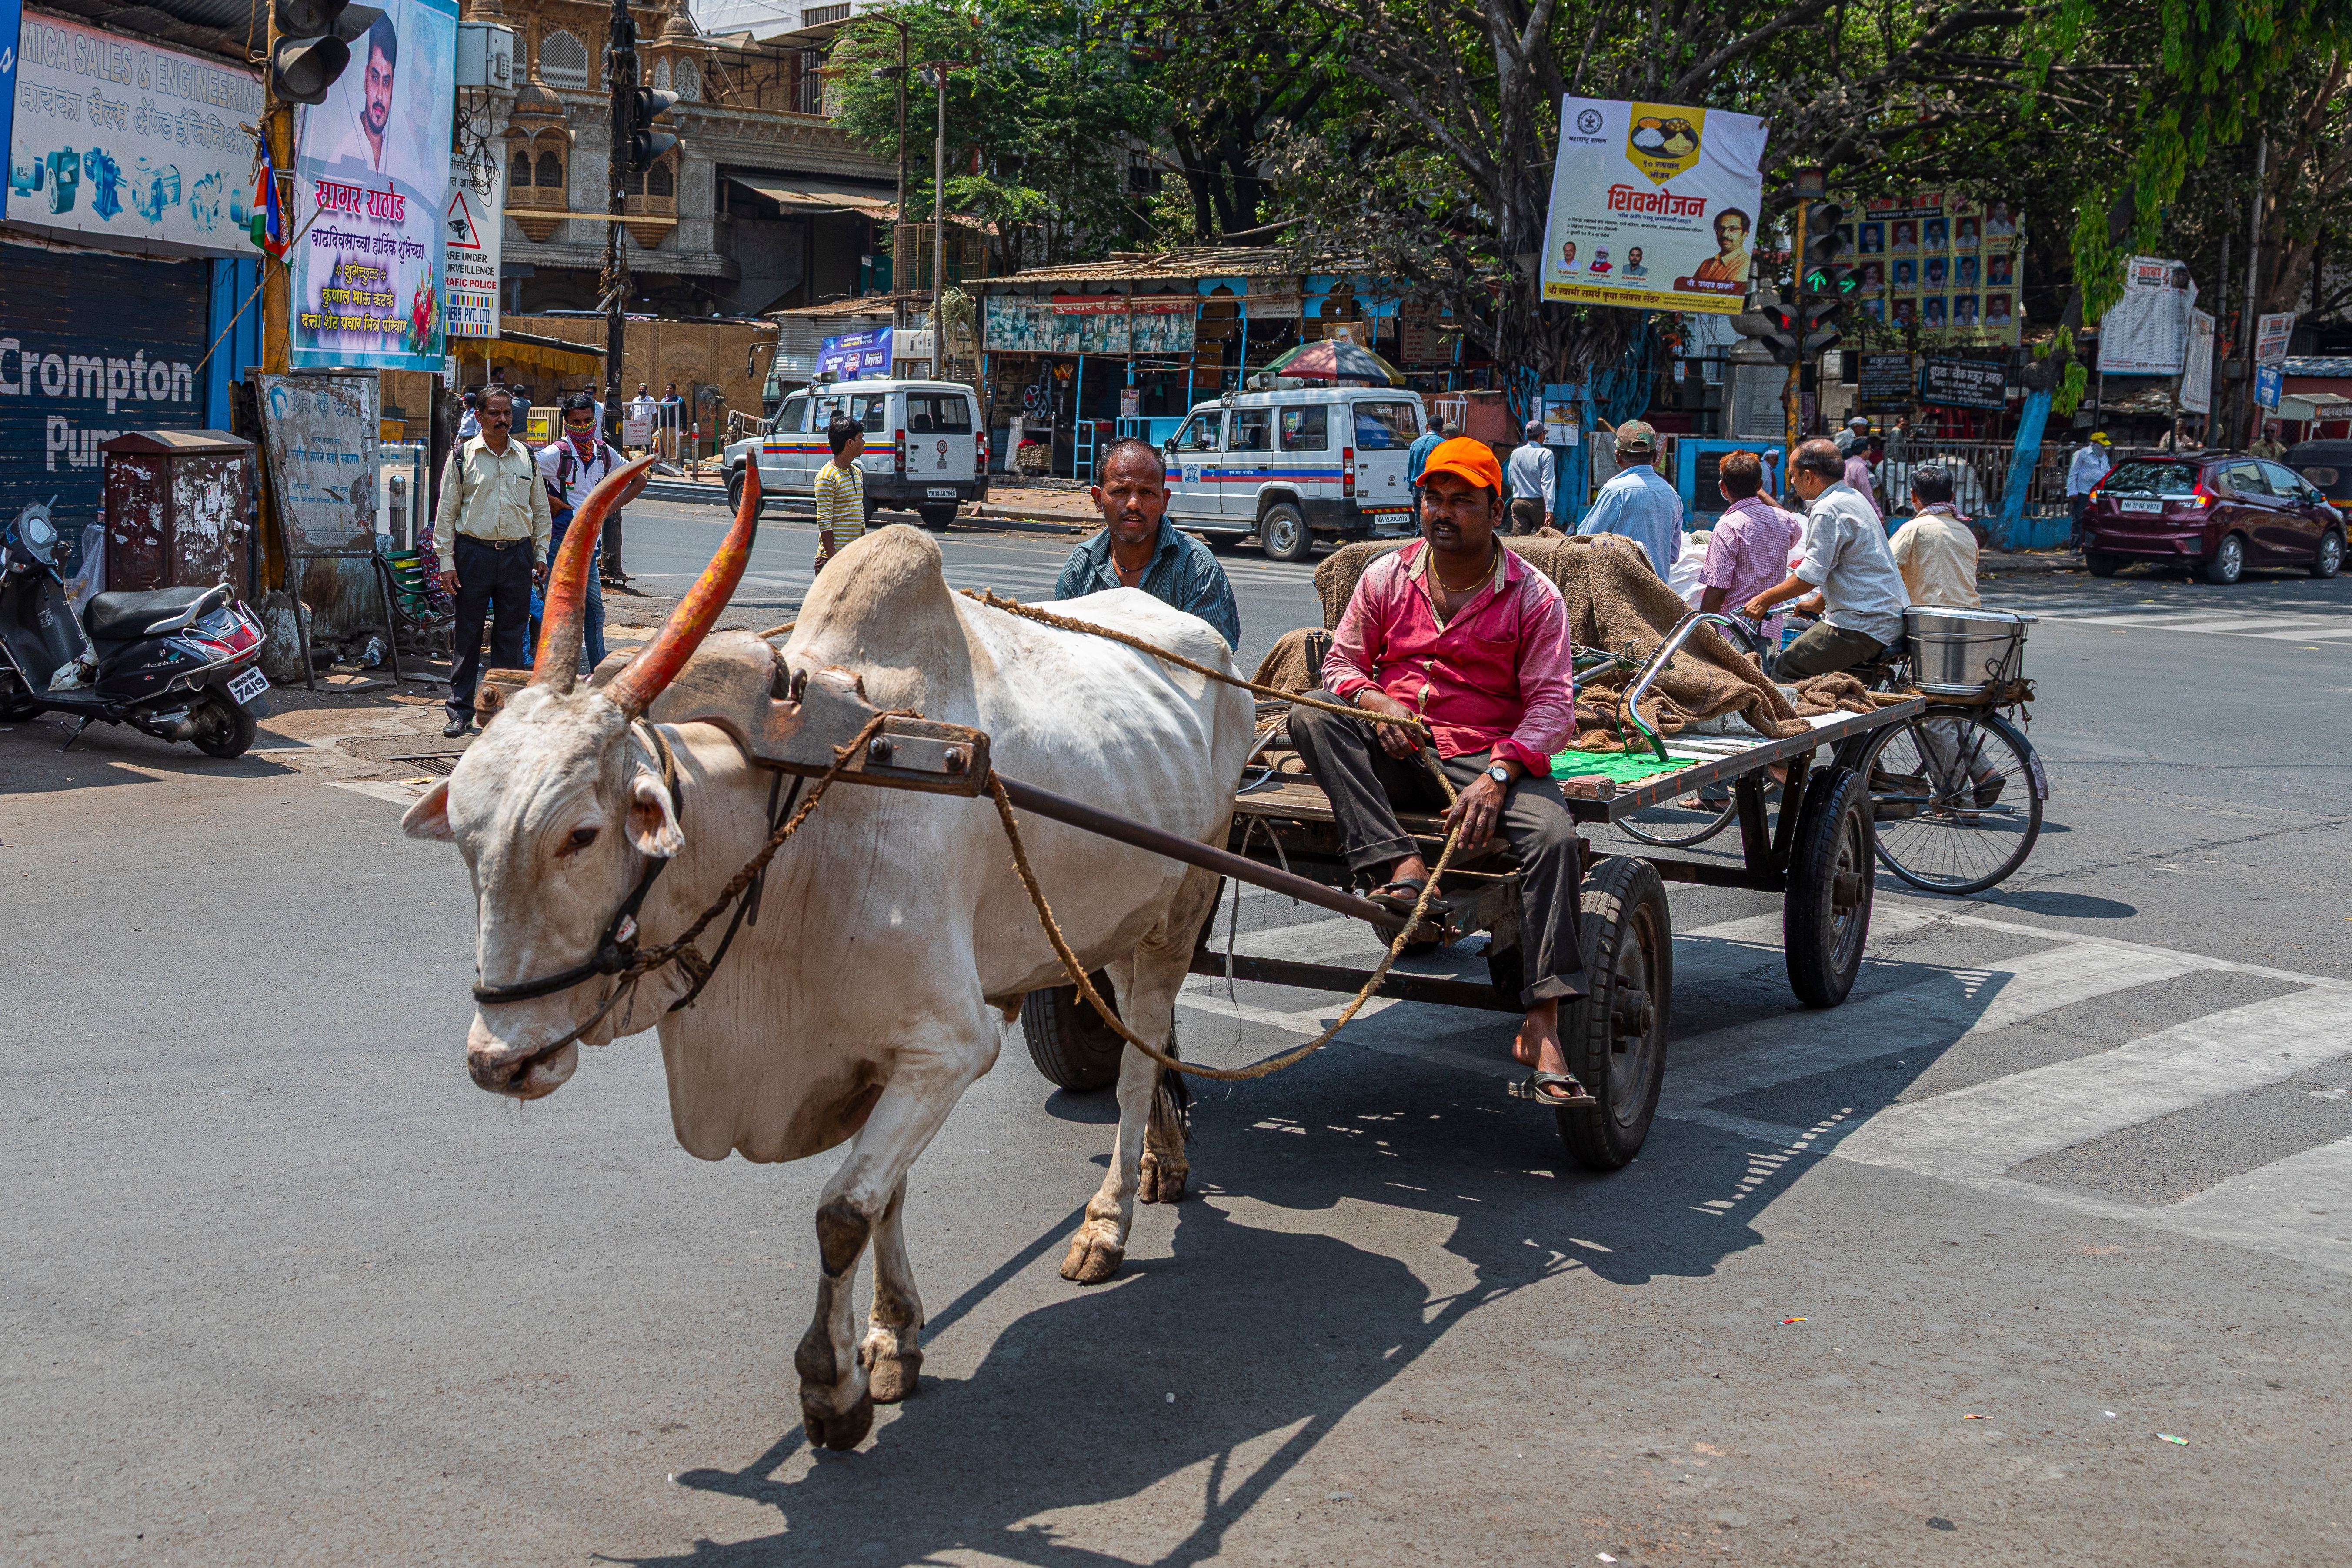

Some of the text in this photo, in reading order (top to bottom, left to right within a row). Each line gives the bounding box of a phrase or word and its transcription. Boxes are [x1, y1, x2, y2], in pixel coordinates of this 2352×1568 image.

[75, 34, 132, 86] SALES
[138, 50, 150, 90] &
[156, 55, 264, 116] ENGINEERING
[19, 80, 81, 122] मायका
[87, 87, 129, 131] सेल्स
[1569, 136, 1589, 144] महाराष्ट्र
[315, 179, 406, 221] सागर राठोड
[1608, 183, 1707, 217] शिवभोजन
[312, 226, 370, 256] वाढदिवसाच्या
[373, 233, 396, 256] हार्दिक
[399, 236, 424, 264] शुभेच्छा
[447, 251, 487, 263] ARE UNDER
[345, 261, 379, 285] शुभेच्छुक
[469, 279, 497, 289] POLICE
[322, 287, 395, 308] कुणाल भाऊ कटके
[1548, 285, 1557, 294] श्री
[1559, 287, 1580, 296] स्वामी
[1582, 288, 1601, 298] समर्थ
[1603, 291, 1618, 302] कृपा
[302, 313, 321, 329] दत्ता
[324, 310, 339, 330] शेठ
[341, 314, 362, 332] पवार
[382, 317, 407, 335] परिवार
[464, 307, 477, 322] PVT.
[480, 309, 491, 323] LTD.
[864, 350, 883, 367] Oxyrich
[0, 337, 192, 414] Crompton
[234, 677, 266, 702] 7419
